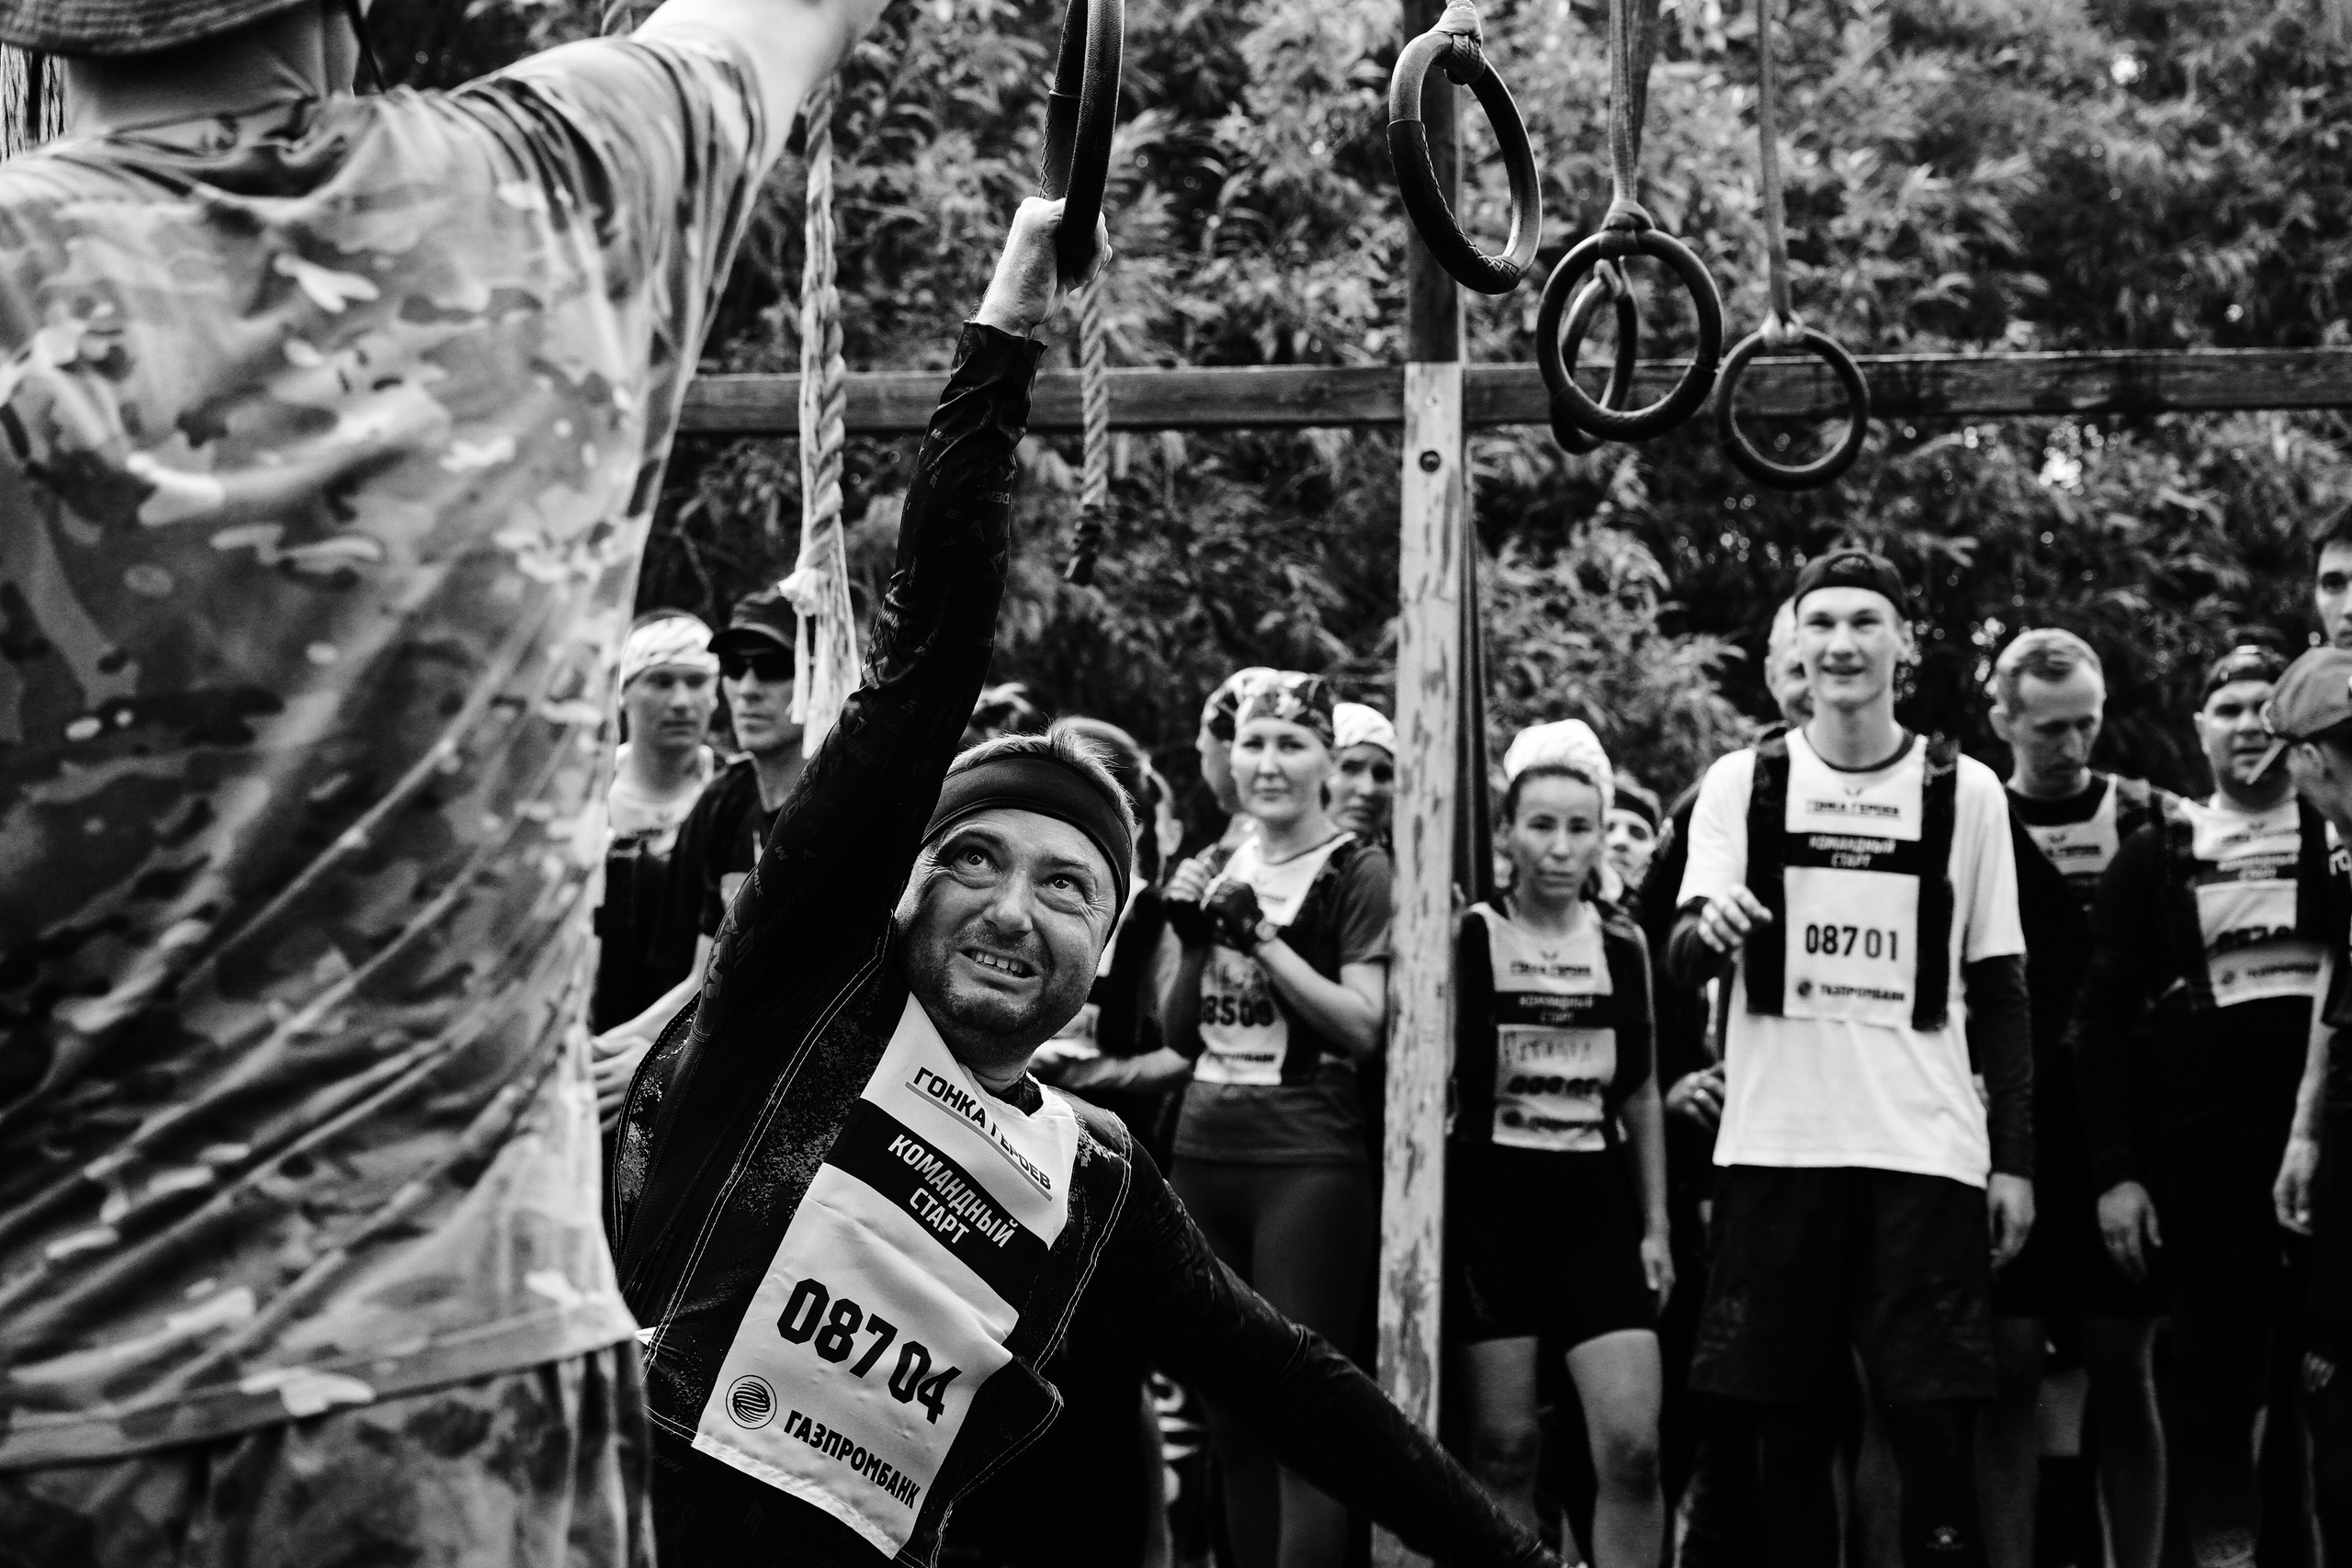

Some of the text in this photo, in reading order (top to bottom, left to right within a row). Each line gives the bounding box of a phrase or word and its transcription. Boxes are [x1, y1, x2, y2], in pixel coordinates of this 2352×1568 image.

[1805, 923, 1897, 961] 08701
[913, 1066, 987, 1129] ГОНКА
[888, 1134, 1019, 1248] КОМАНДНЫЙ
[910, 1187, 970, 1245] СТАРТ
[777, 1278, 963, 1426] 08704
[784, 1409, 922, 1509] ГАЗПРОМБАНК
